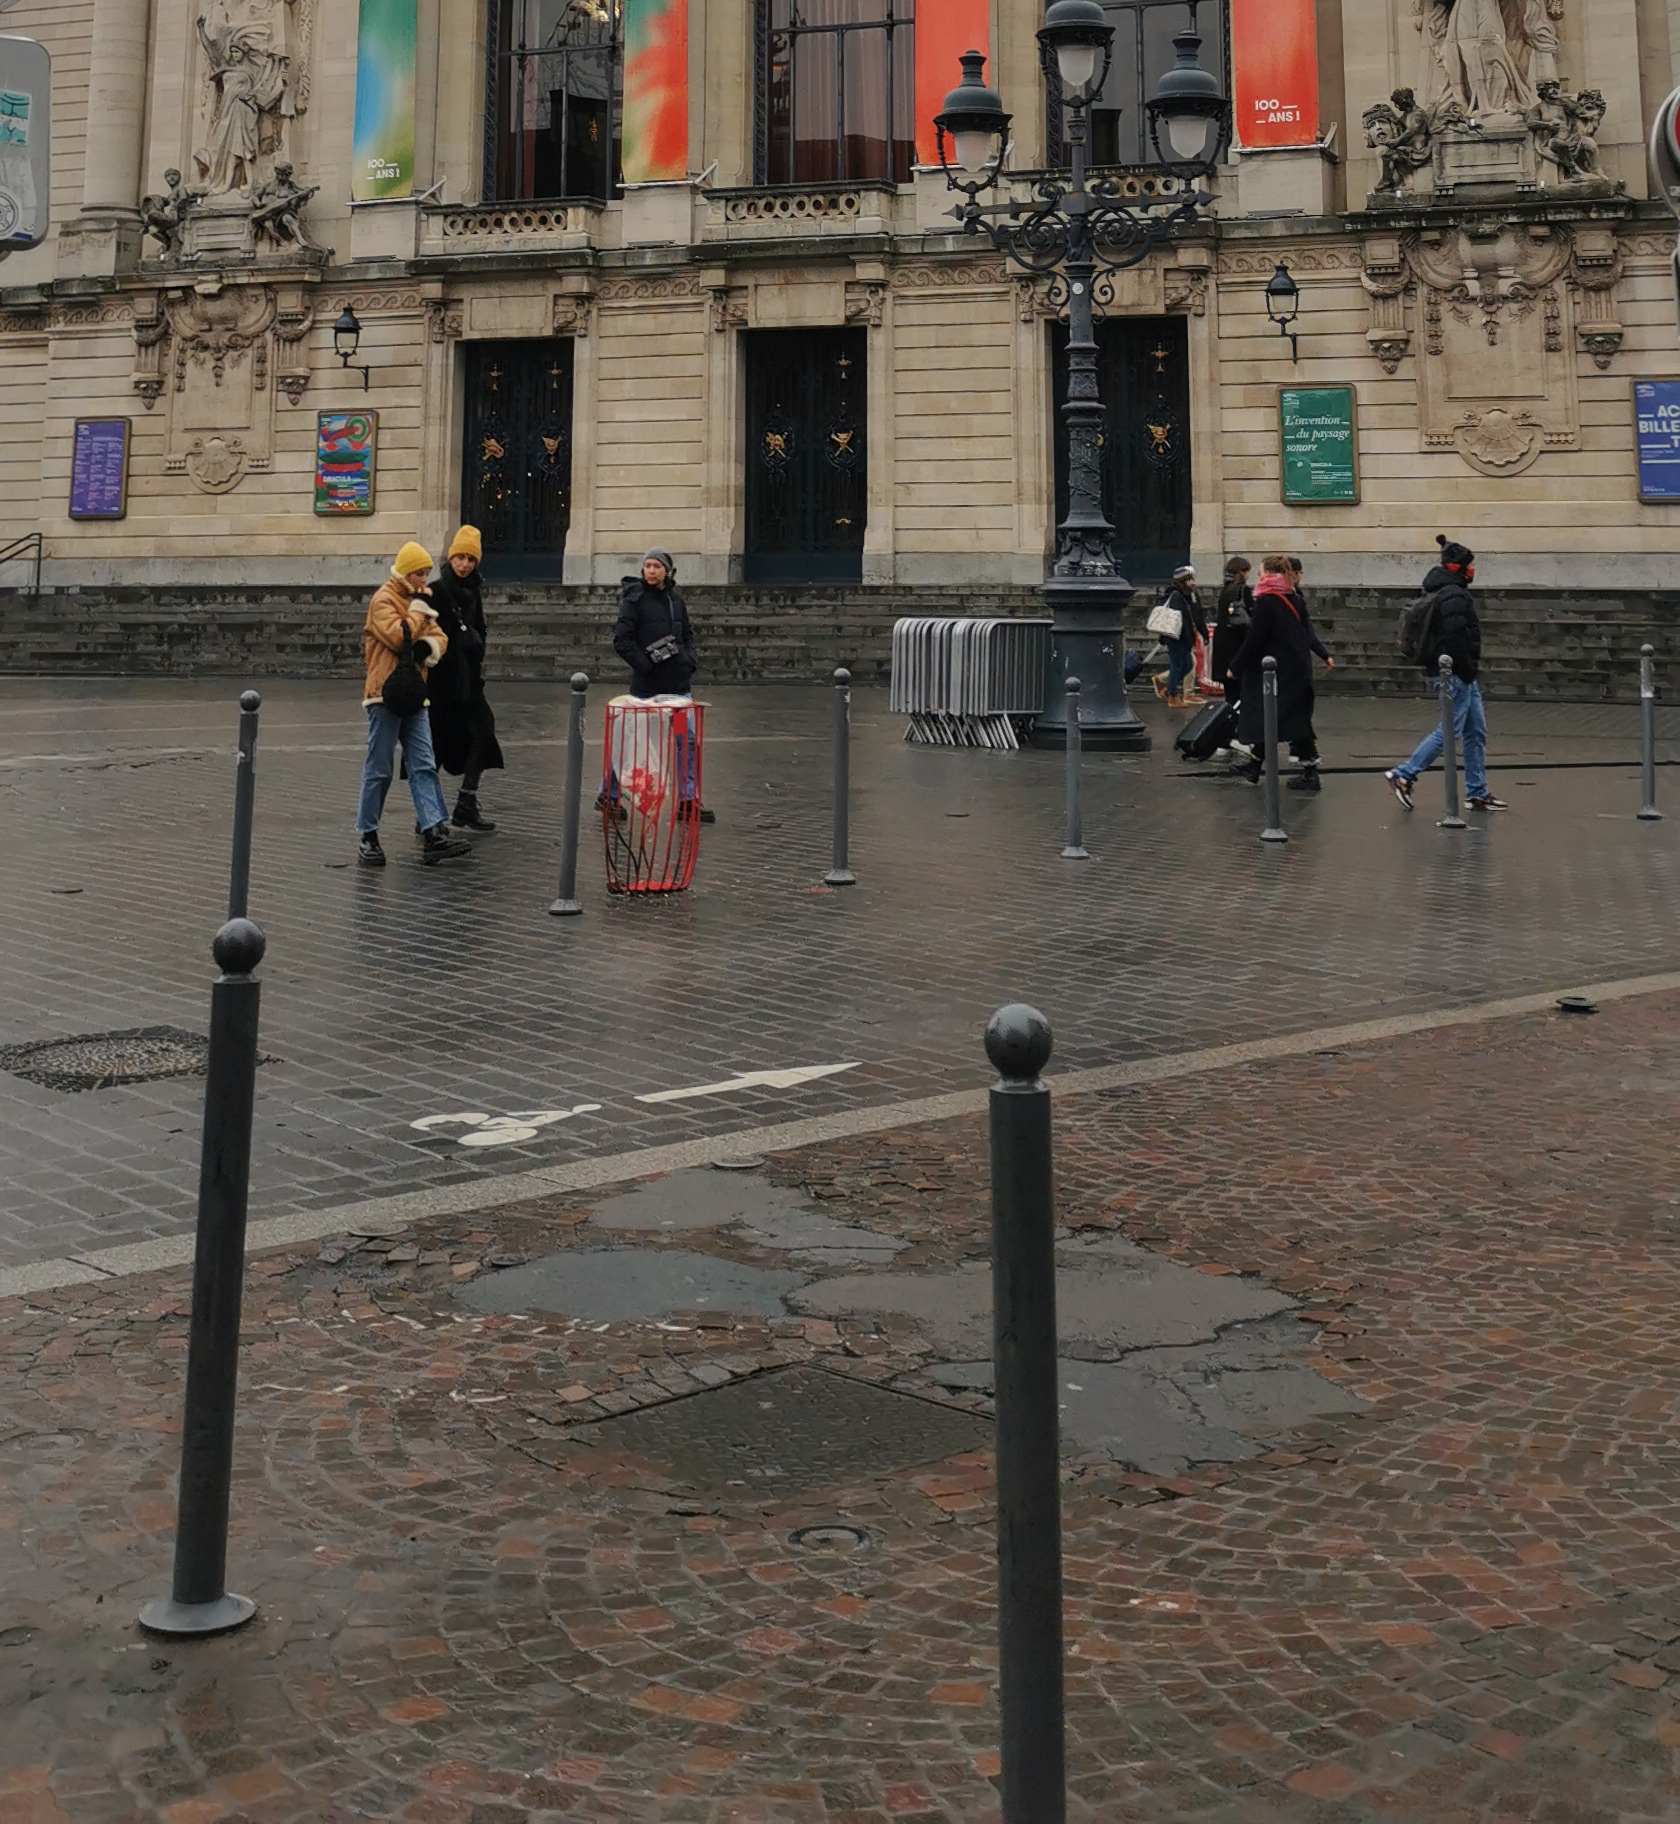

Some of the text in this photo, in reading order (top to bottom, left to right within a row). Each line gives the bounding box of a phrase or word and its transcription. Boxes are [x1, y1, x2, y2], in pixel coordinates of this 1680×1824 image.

[1254, 98, 1280, 111] 100
[1267, 111, 1294, 123] ANS
[367, 158, 385, 169] 100
[375, 168, 395, 179] ANS
[1657, 404, 1680, 418] AC
[1638, 420, 1680, 434] BILLE
[1296, 428, 1351, 442] du paysage
[1285, 443, 1318, 452] sonore
